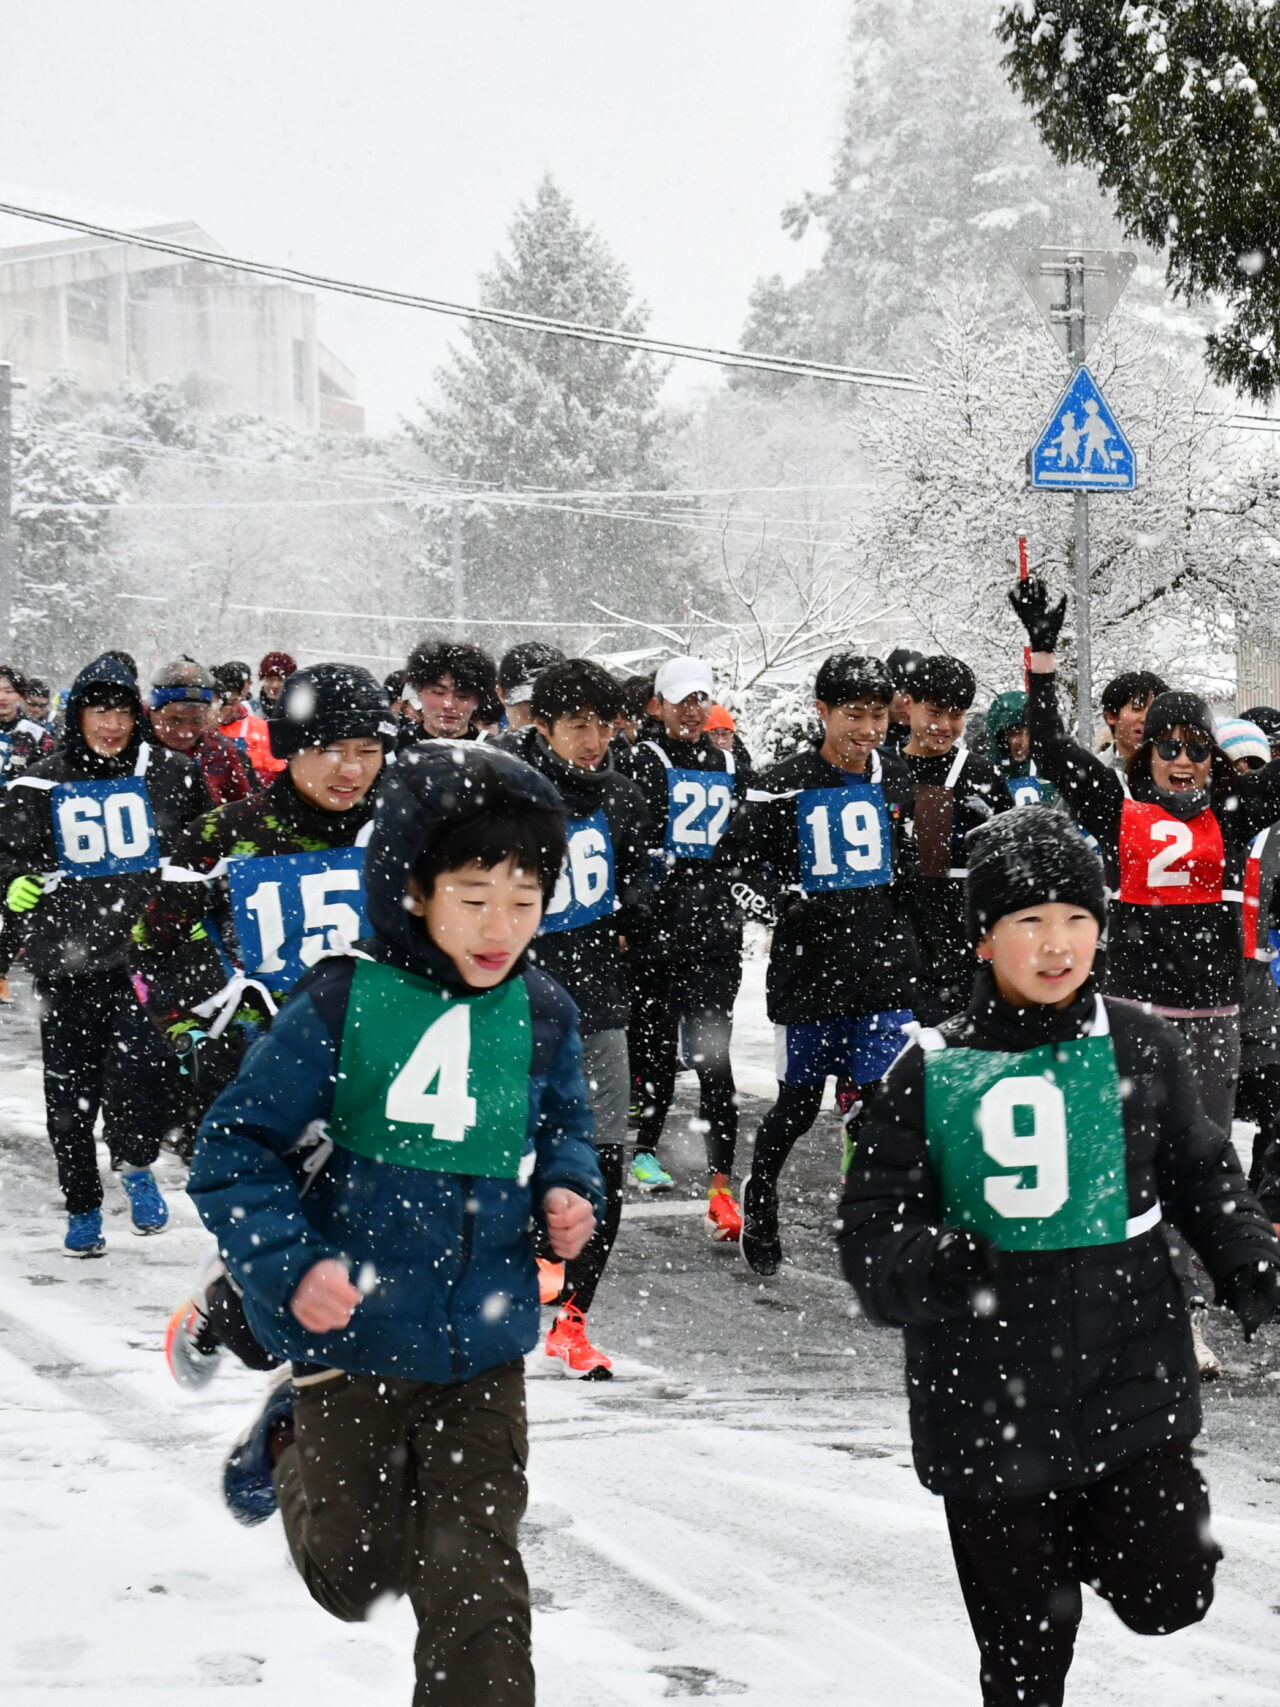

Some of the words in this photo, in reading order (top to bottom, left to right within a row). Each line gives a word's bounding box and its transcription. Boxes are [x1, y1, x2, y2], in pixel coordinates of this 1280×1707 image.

[58, 793, 152, 863] 60
[672, 782, 731, 845] 22
[806, 801, 882, 877] 19
[1147, 820, 1192, 887] 2
[246, 869, 360, 974] 15
[385, 1003, 477, 1141] 4
[981, 1076, 1069, 1217] 9
